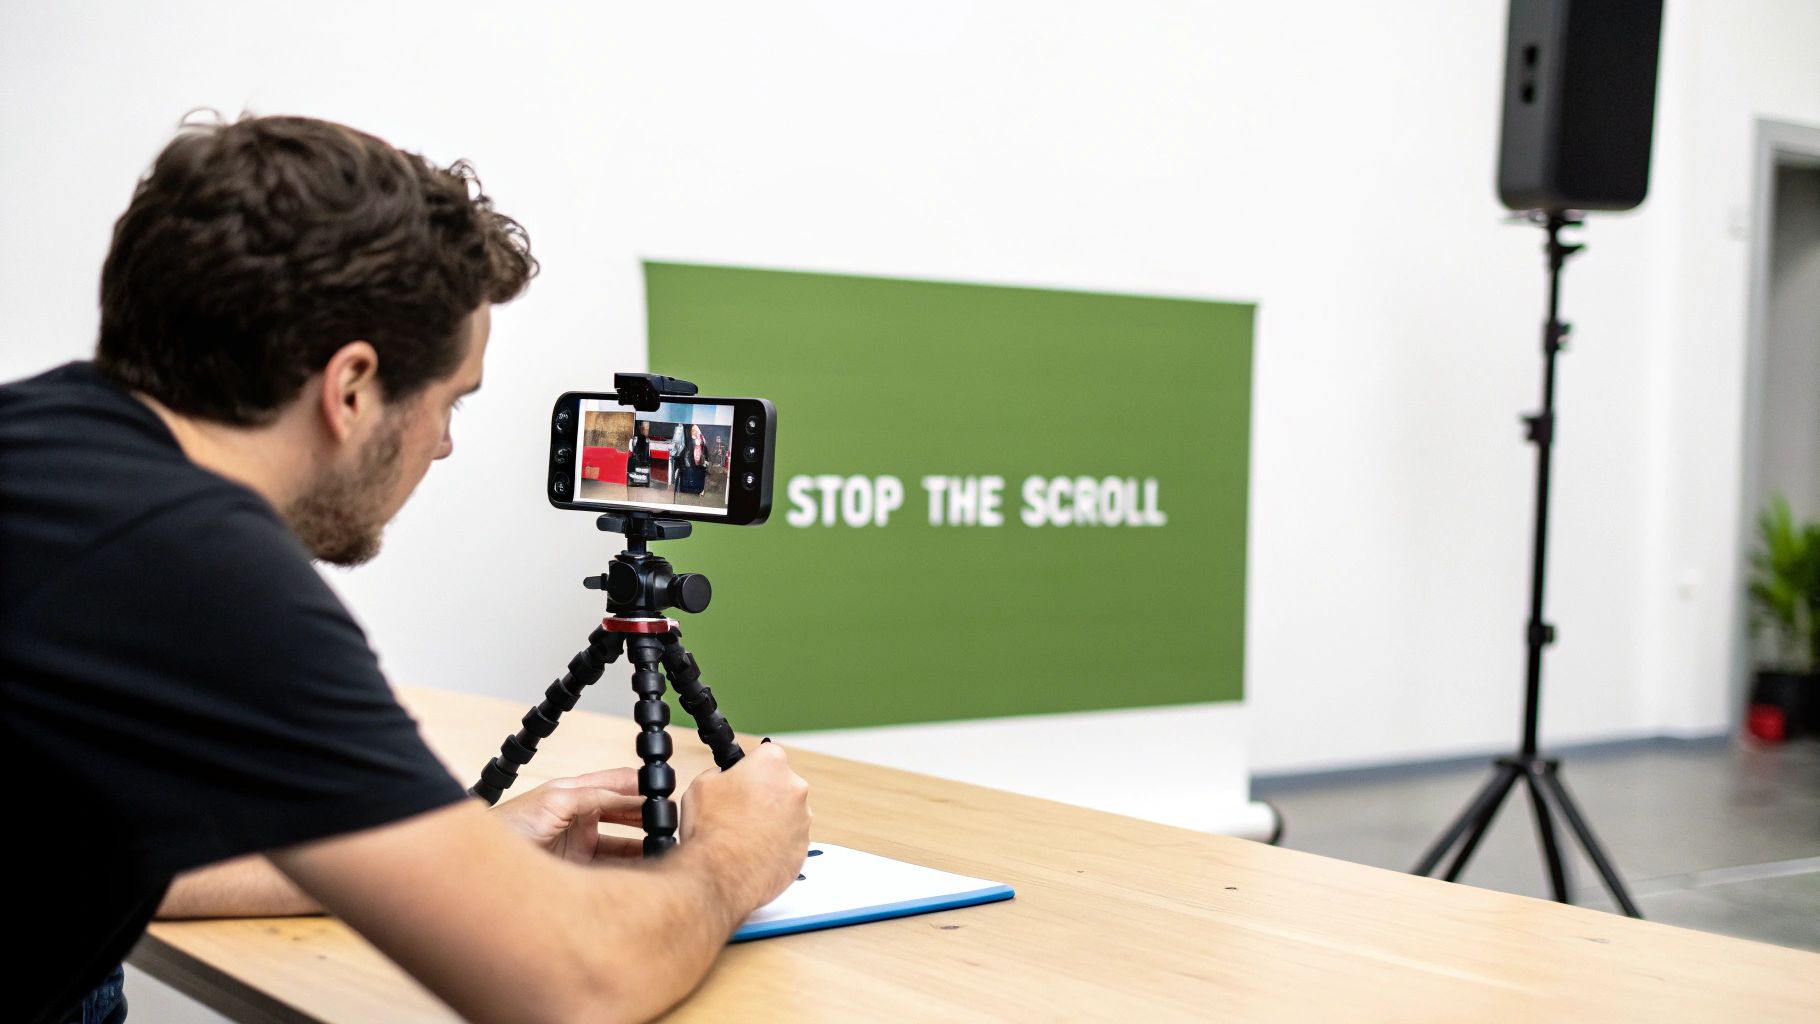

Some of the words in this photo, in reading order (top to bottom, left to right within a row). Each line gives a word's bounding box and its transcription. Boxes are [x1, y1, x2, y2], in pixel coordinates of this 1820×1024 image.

[787, 475, 904, 527] STOP
[923, 475, 1005, 527] THE
[1020, 475, 1167, 527] SCROLL
